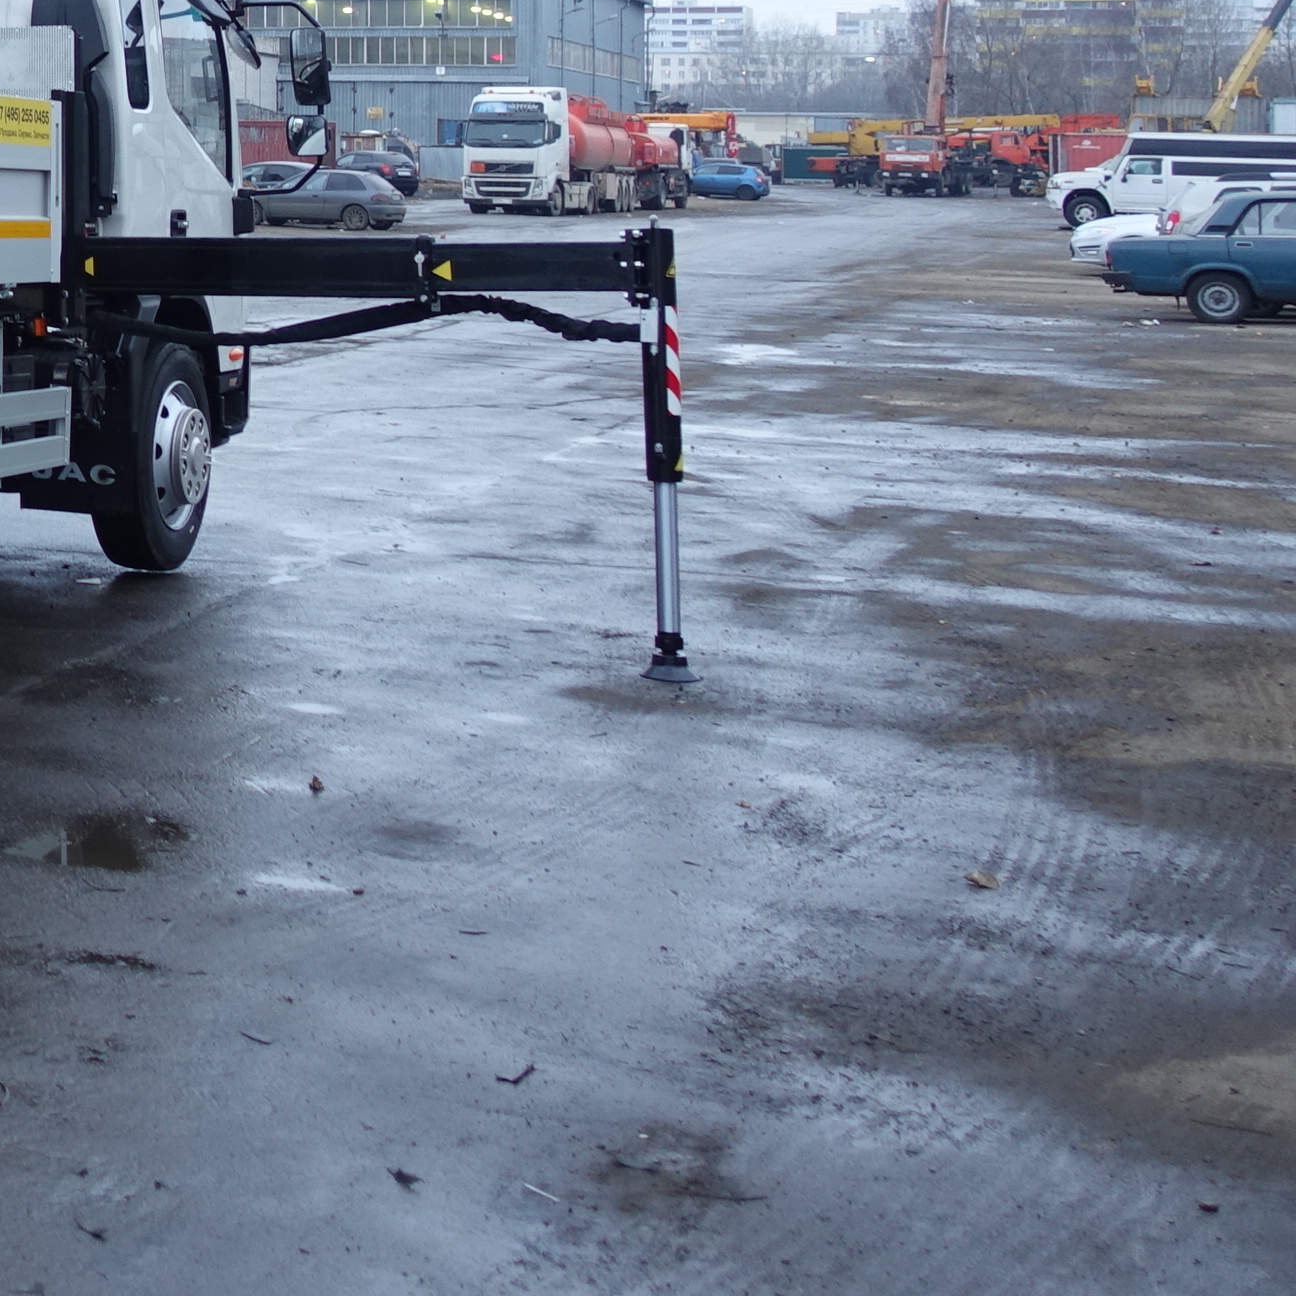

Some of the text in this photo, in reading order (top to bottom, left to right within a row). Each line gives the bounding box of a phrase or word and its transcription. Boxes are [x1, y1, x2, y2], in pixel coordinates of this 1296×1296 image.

[4, 107, 21, 125] (495)
[21, 108, 33, 124] 255
[34, 110, 50, 125] 0455
